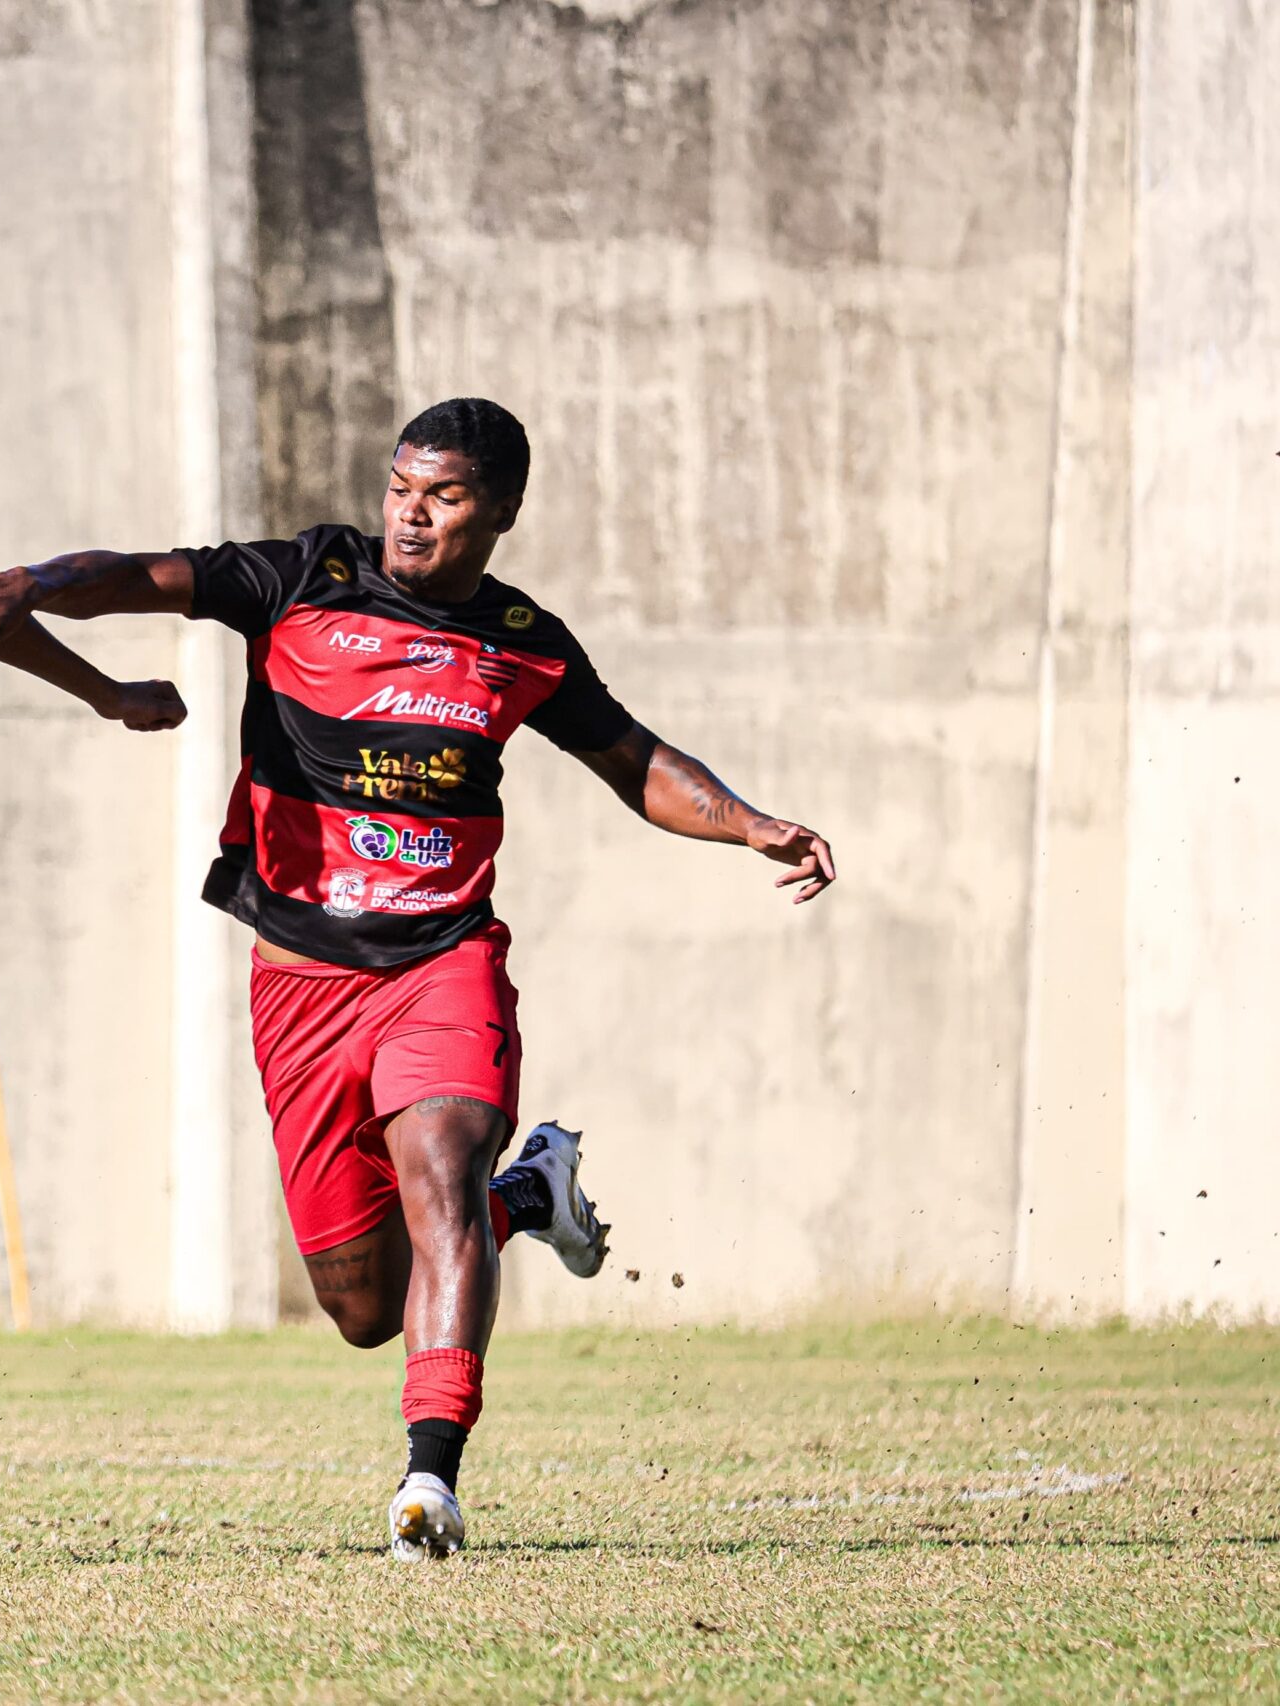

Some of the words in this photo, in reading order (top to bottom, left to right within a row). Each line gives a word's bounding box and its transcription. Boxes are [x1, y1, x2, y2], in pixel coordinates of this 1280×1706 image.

[406, 643, 456, 661] Pier
[340, 685, 488, 728] Multifrios
[358, 748, 427, 780] Vale
[400, 828, 452, 852] Luiz
[400, 851, 418, 863] da
[418, 851, 450, 867] Uva
[370, 897, 430, 912] D'AJUDA
[373, 886, 458, 903] ITAPORANGA
[486, 1020, 509, 1068] 7
